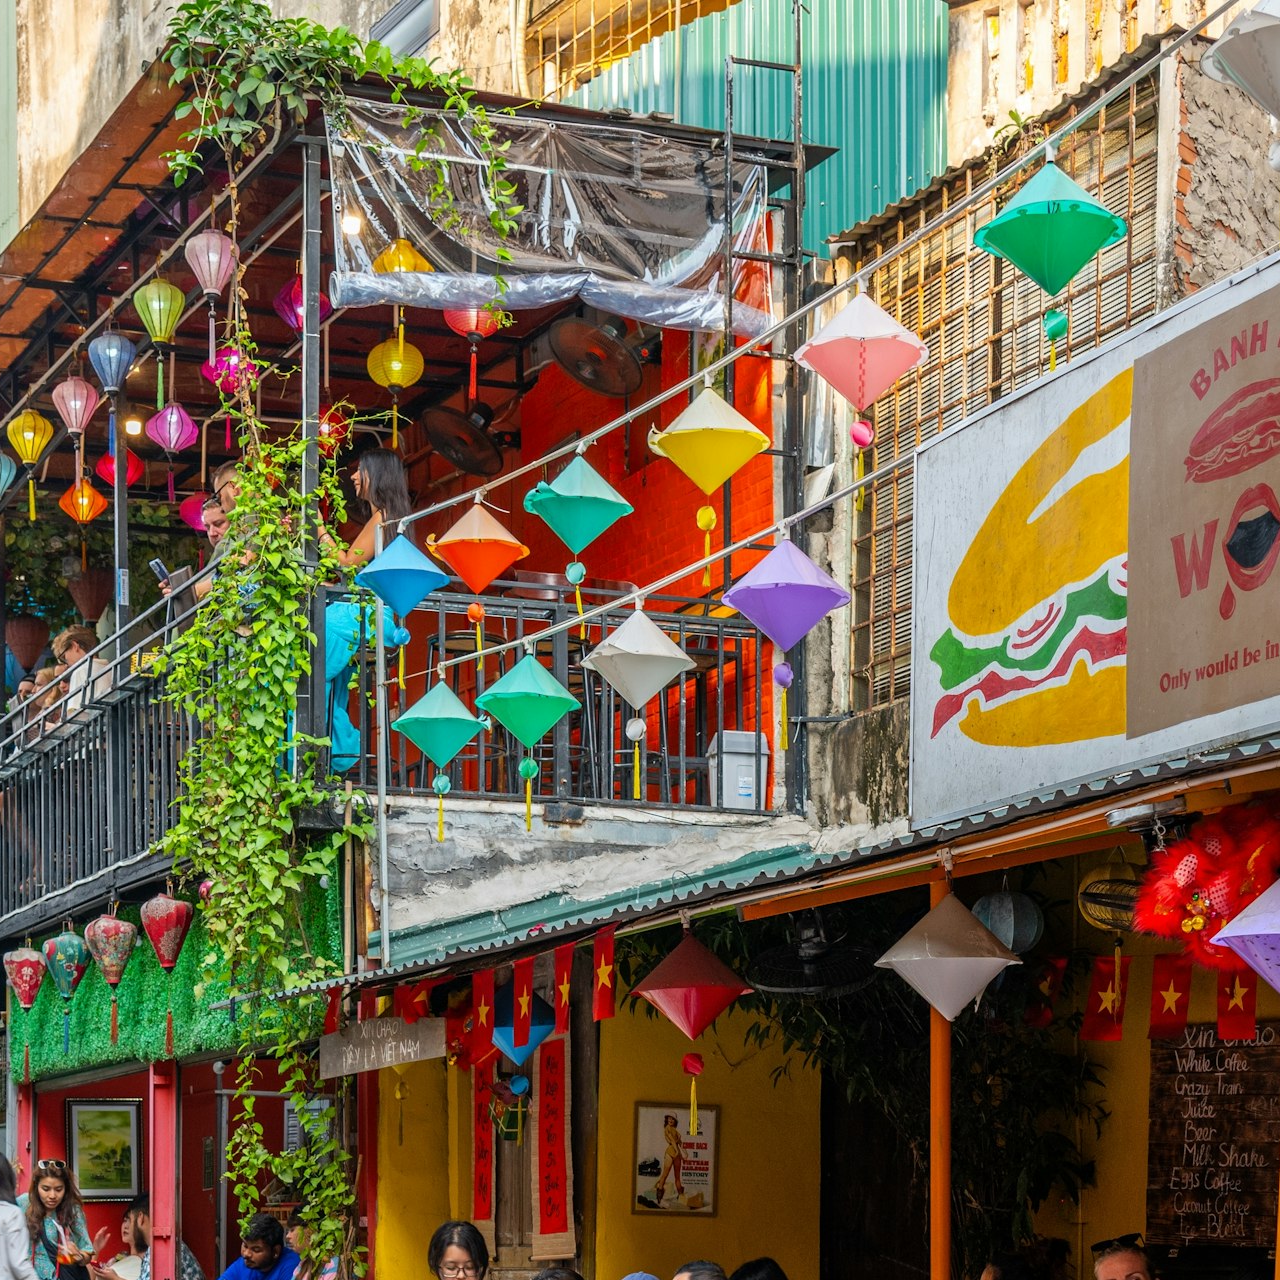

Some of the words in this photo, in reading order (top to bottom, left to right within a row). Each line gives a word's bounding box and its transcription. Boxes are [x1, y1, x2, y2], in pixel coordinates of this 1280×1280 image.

[1189, 319, 1269, 401] BANH
[1159, 668, 1191, 693] Only
[1195, 651, 1239, 682] would
[1242, 647, 1261, 668] be
[1265, 640, 1280, 660] in
[360, 1021, 375, 1039] XIN
[1179, 1025, 1216, 1048] Xin
[399, 1039, 420, 1062] NAM
[1175, 1050, 1214, 1072] White
[1215, 1049, 1251, 1072] Coffee
[1174, 1073, 1210, 1101] Crazy
[1214, 1072, 1244, 1096] Train
[1180, 1097, 1217, 1118] Juice
[1184, 1121, 1218, 1142] Beer
[1182, 1143, 1215, 1167] Milk
[1217, 1142, 1270, 1168] Shake
[1169, 1167, 1201, 1191] Eggs
[1204, 1168, 1242, 1195] Coffee
[1214, 1195, 1251, 1216] Coffee
